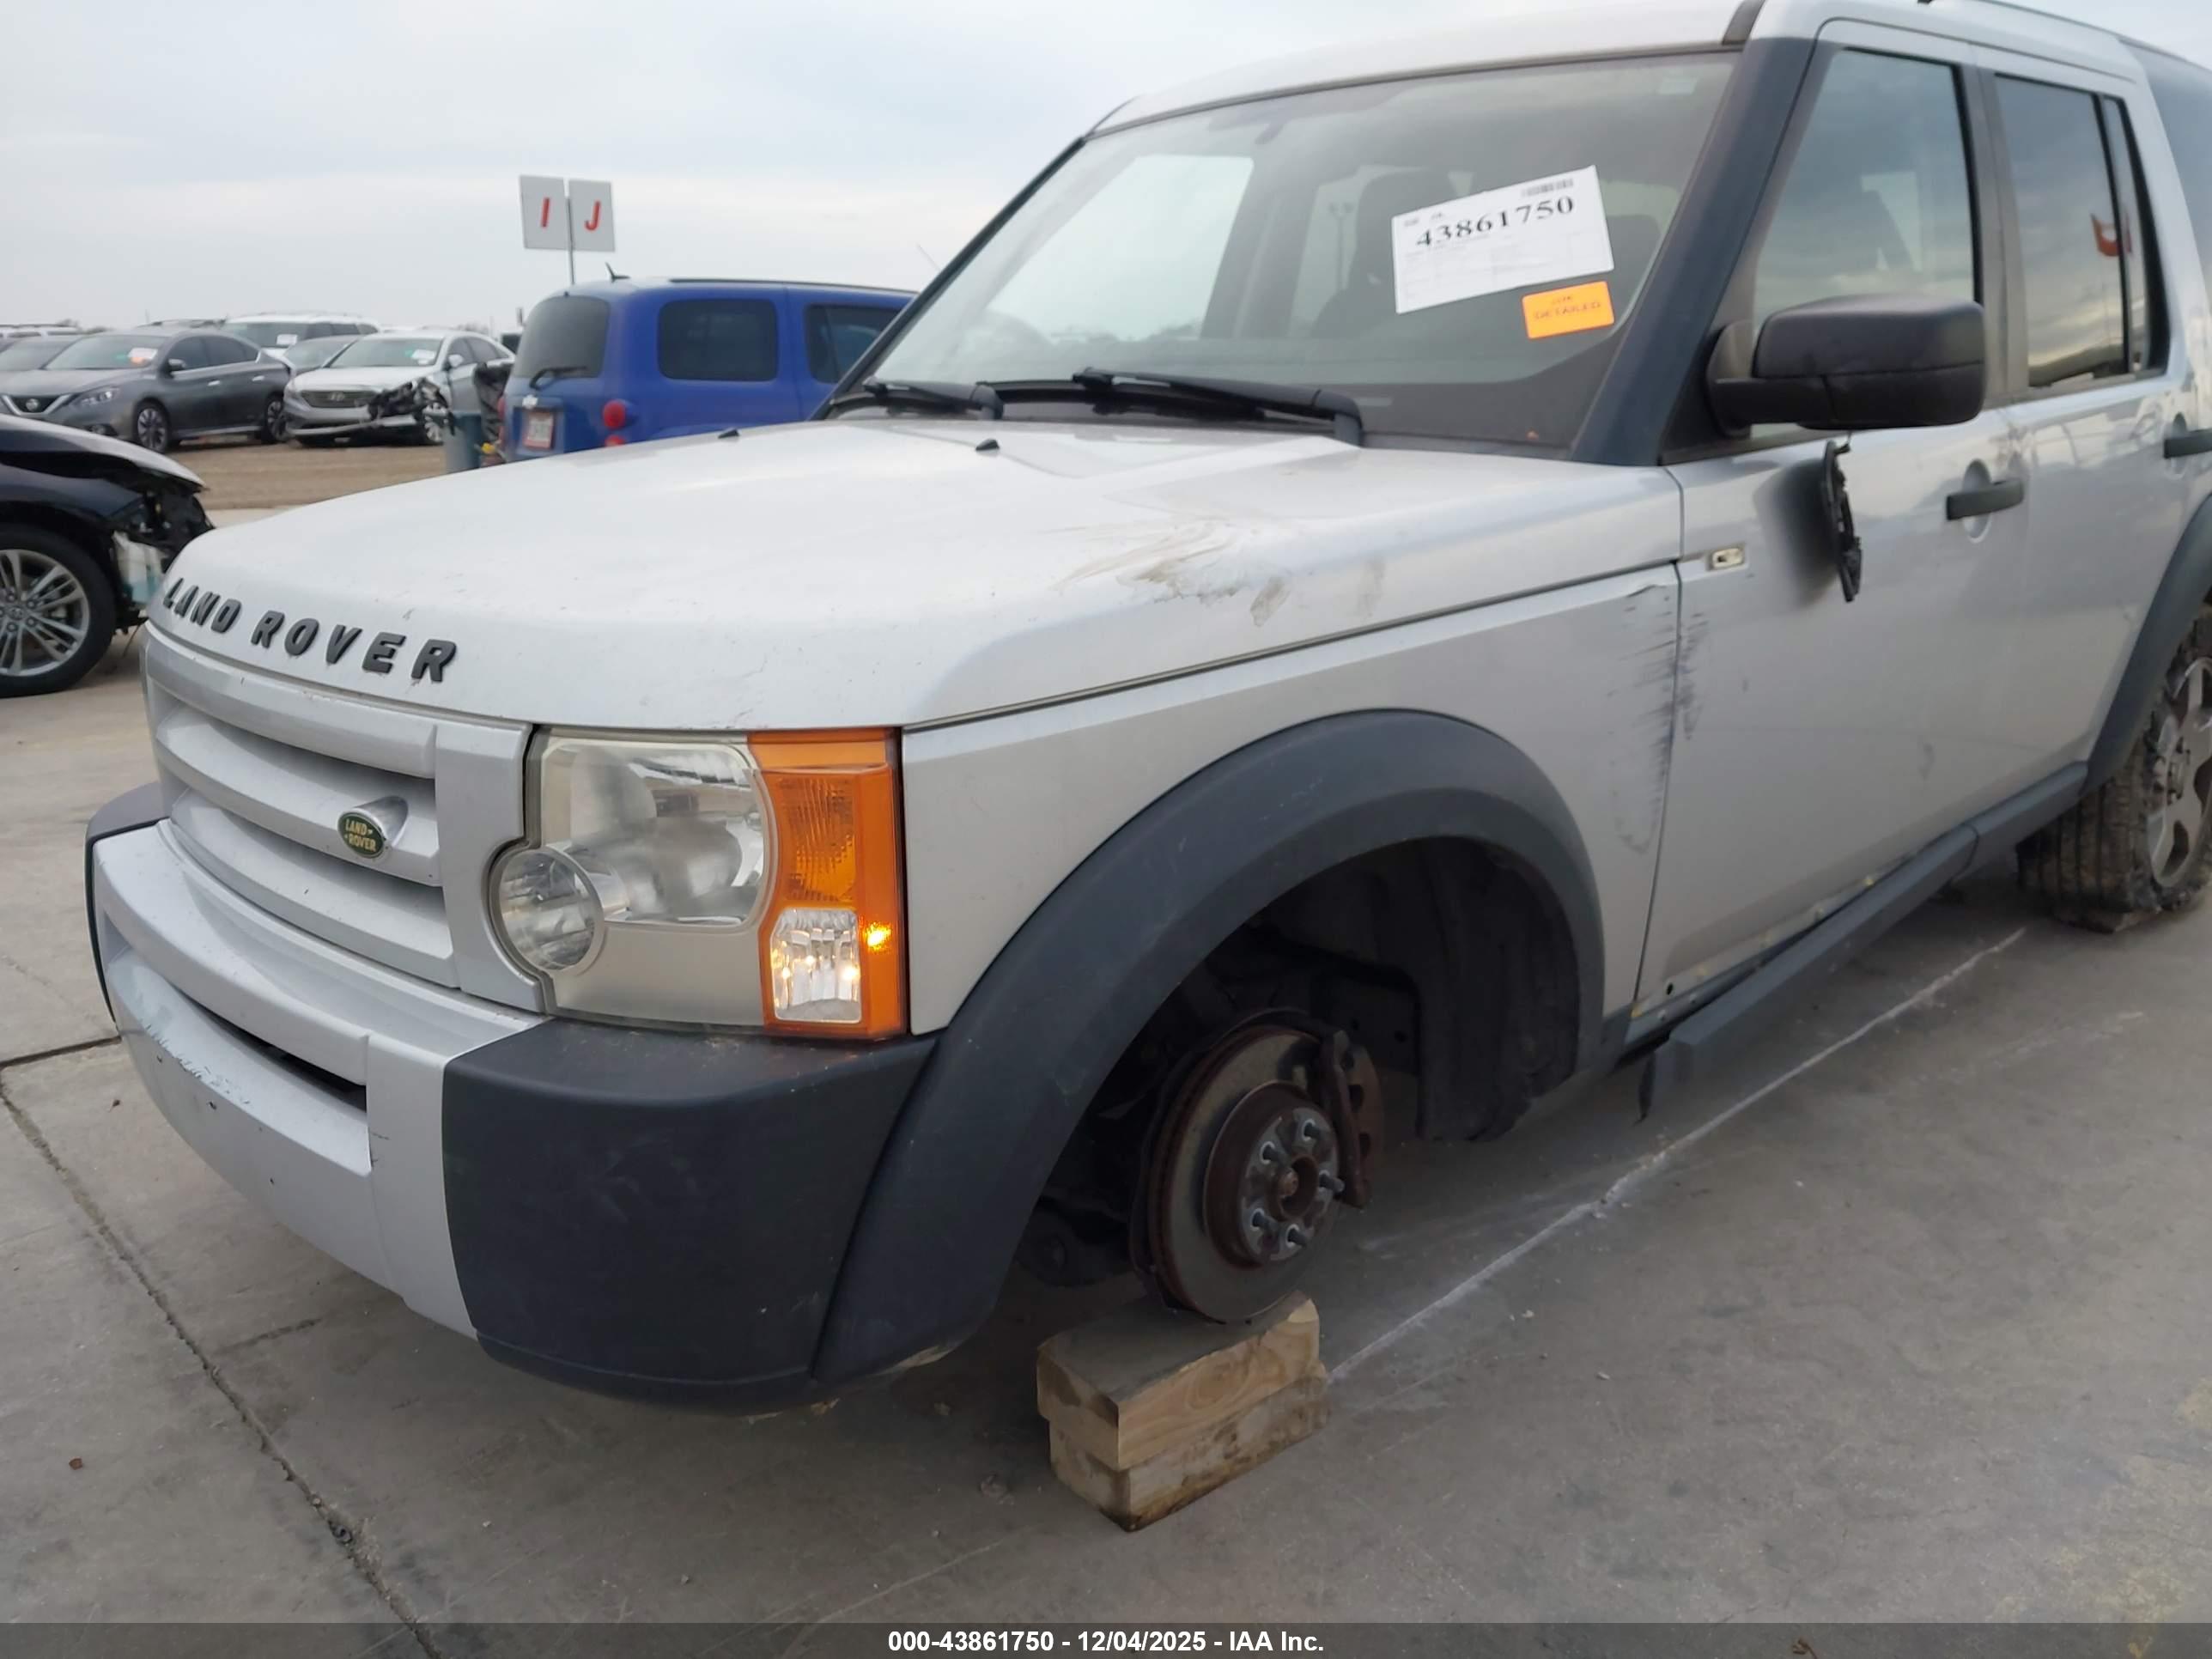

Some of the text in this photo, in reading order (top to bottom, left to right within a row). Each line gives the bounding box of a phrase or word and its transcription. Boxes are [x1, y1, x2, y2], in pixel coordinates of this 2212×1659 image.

[584, 200, 601, 231] J
[1416, 196, 1574, 246] 43861750
[163, 577, 458, 683] LAND ROVER
[345, 818, 368, 836] LAND
[349, 833, 377, 852] ROVER
